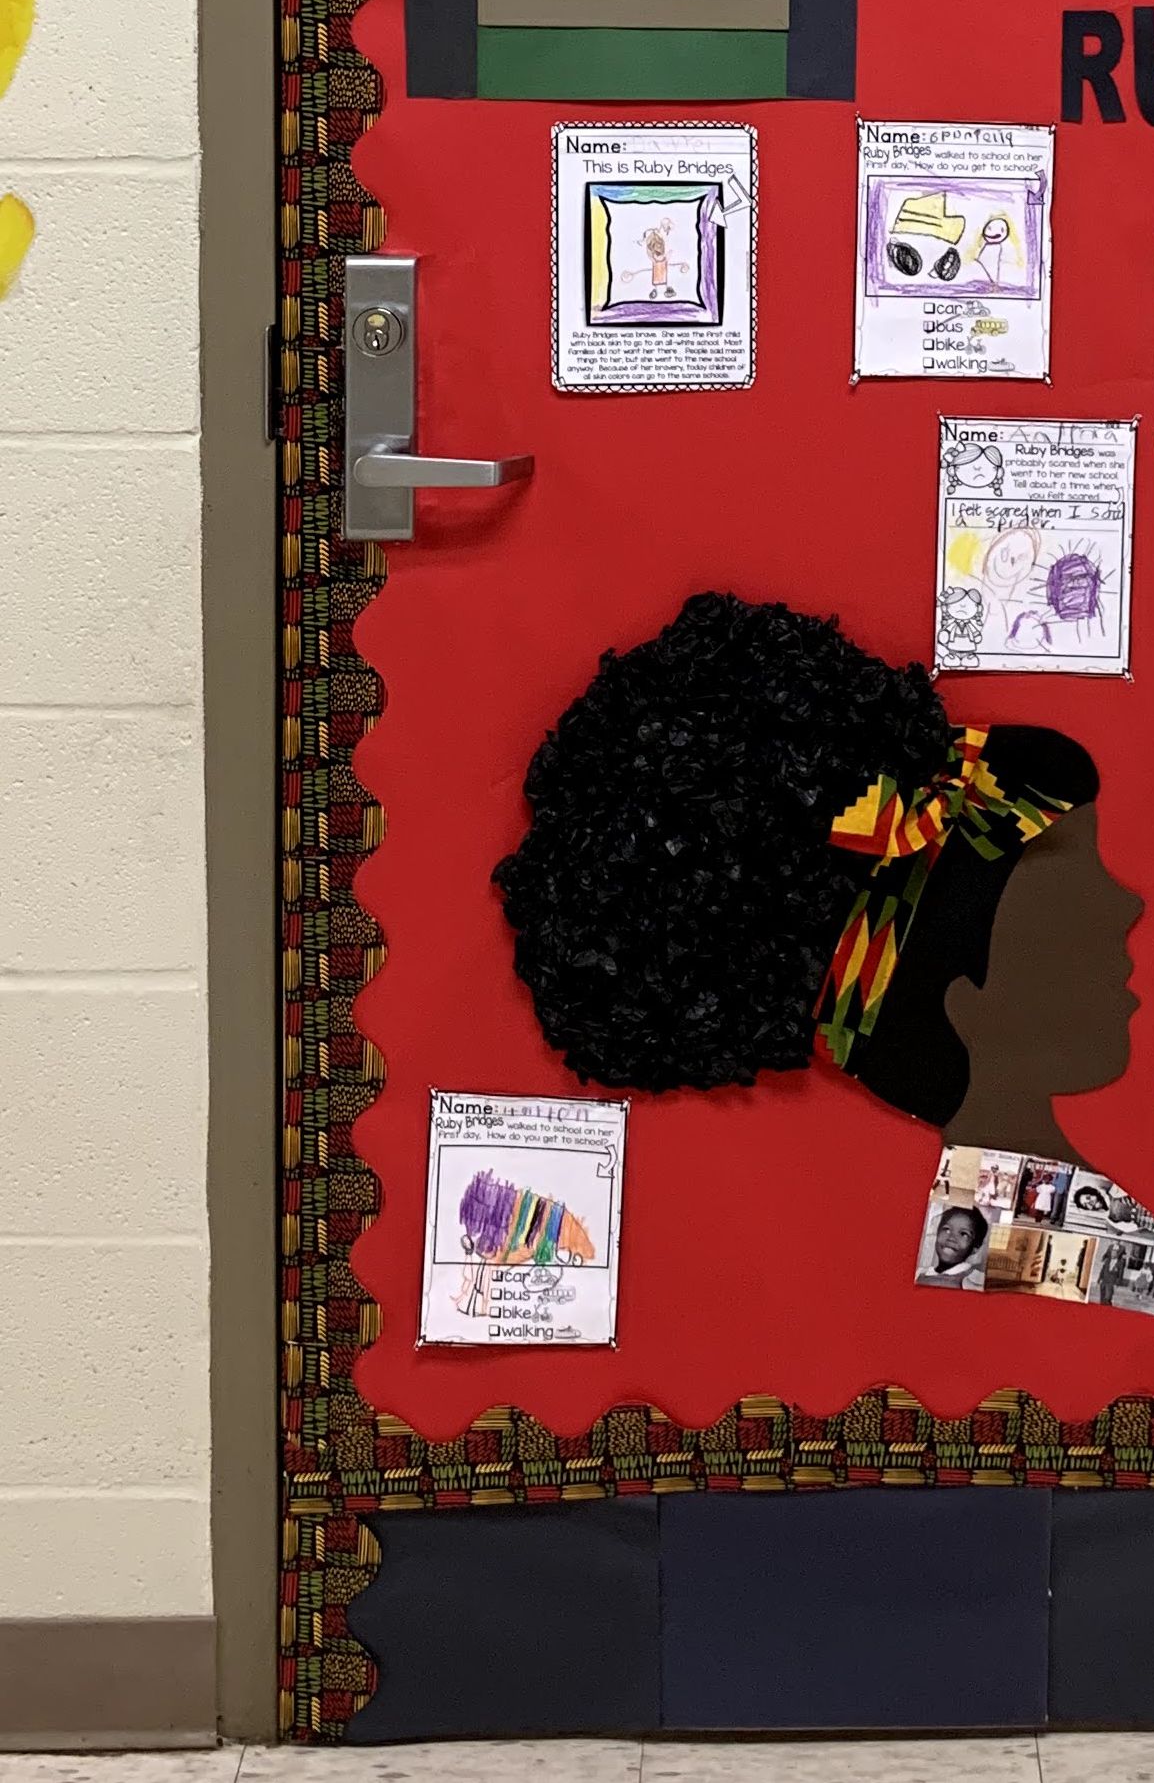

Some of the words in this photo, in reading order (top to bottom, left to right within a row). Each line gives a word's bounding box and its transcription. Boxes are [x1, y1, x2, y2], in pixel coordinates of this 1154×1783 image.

[867, 126, 926, 144] Name:
[566, 136, 627, 153] Name:
[863, 147, 889, 163] Ruby
[893, 142, 932, 158] Bridges
[935, 151, 964, 160] walked
[968, 152, 978, 160] to
[981, 152, 1011, 161] school
[1027, 153, 1042, 161] her
[583, 160, 612, 173] This
[617, 161, 628, 173] is
[634, 160, 672, 176] Ruby
[952, 164, 968, 173] you
[972, 164, 986, 173] get
[1004, 164, 1038, 172] school?
[936, 303, 962, 315] car
[936, 321, 963, 333] bus
[936, 339, 965, 351] bike
[936, 357, 987, 372] walking
[945, 424, 1003, 442] Name:
[1015, 444, 1046, 460] Ruby
[1050, 445, 1094, 462] Bridges
[1005, 459, 1045, 469] probably
[1049, 460, 1080, 468] scared
[1083, 461, 1107, 469] when
[1109, 461, 1124, 469] she
[1011, 470, 1032, 478] went
[1037, 470, 1046, 478] to
[1049, 471, 1065, 479] her
[1014, 480, 1026, 488] Tell
[1029, 481, 1057, 489] about
[1069, 481, 1090, 490] time
[1093, 482, 1116, 491] when
[1029, 493, 1045, 501] you
[958, 503, 981, 518] felt
[985, 503, 1030, 520] scared
[1031, 505, 1061, 519] when
[1067, 506, 1082, 519] I
[440, 1097, 499, 1115] Name:
[435, 1117, 462, 1133] Ruby
[466, 1114, 504, 1130] Bridges
[506, 1122, 537, 1131] walked
[540, 1123, 551, 1131] to
[553, 1124, 582, 1134] school
[598, 1126, 614, 1135] her
[438, 1131, 460, 1139] first
[487, 1133, 506, 1141] How
[523, 1136, 540, 1144] you
[543, 1135, 558, 1144] get
[561, 1135, 573, 1143] to
[575, 1136, 609, 1146] school?
[504, 1271, 529, 1283] car
[502, 1289, 530, 1301] bus
[501, 1306, 531, 1319] bike
[500, 1324, 554, 1340] walking
